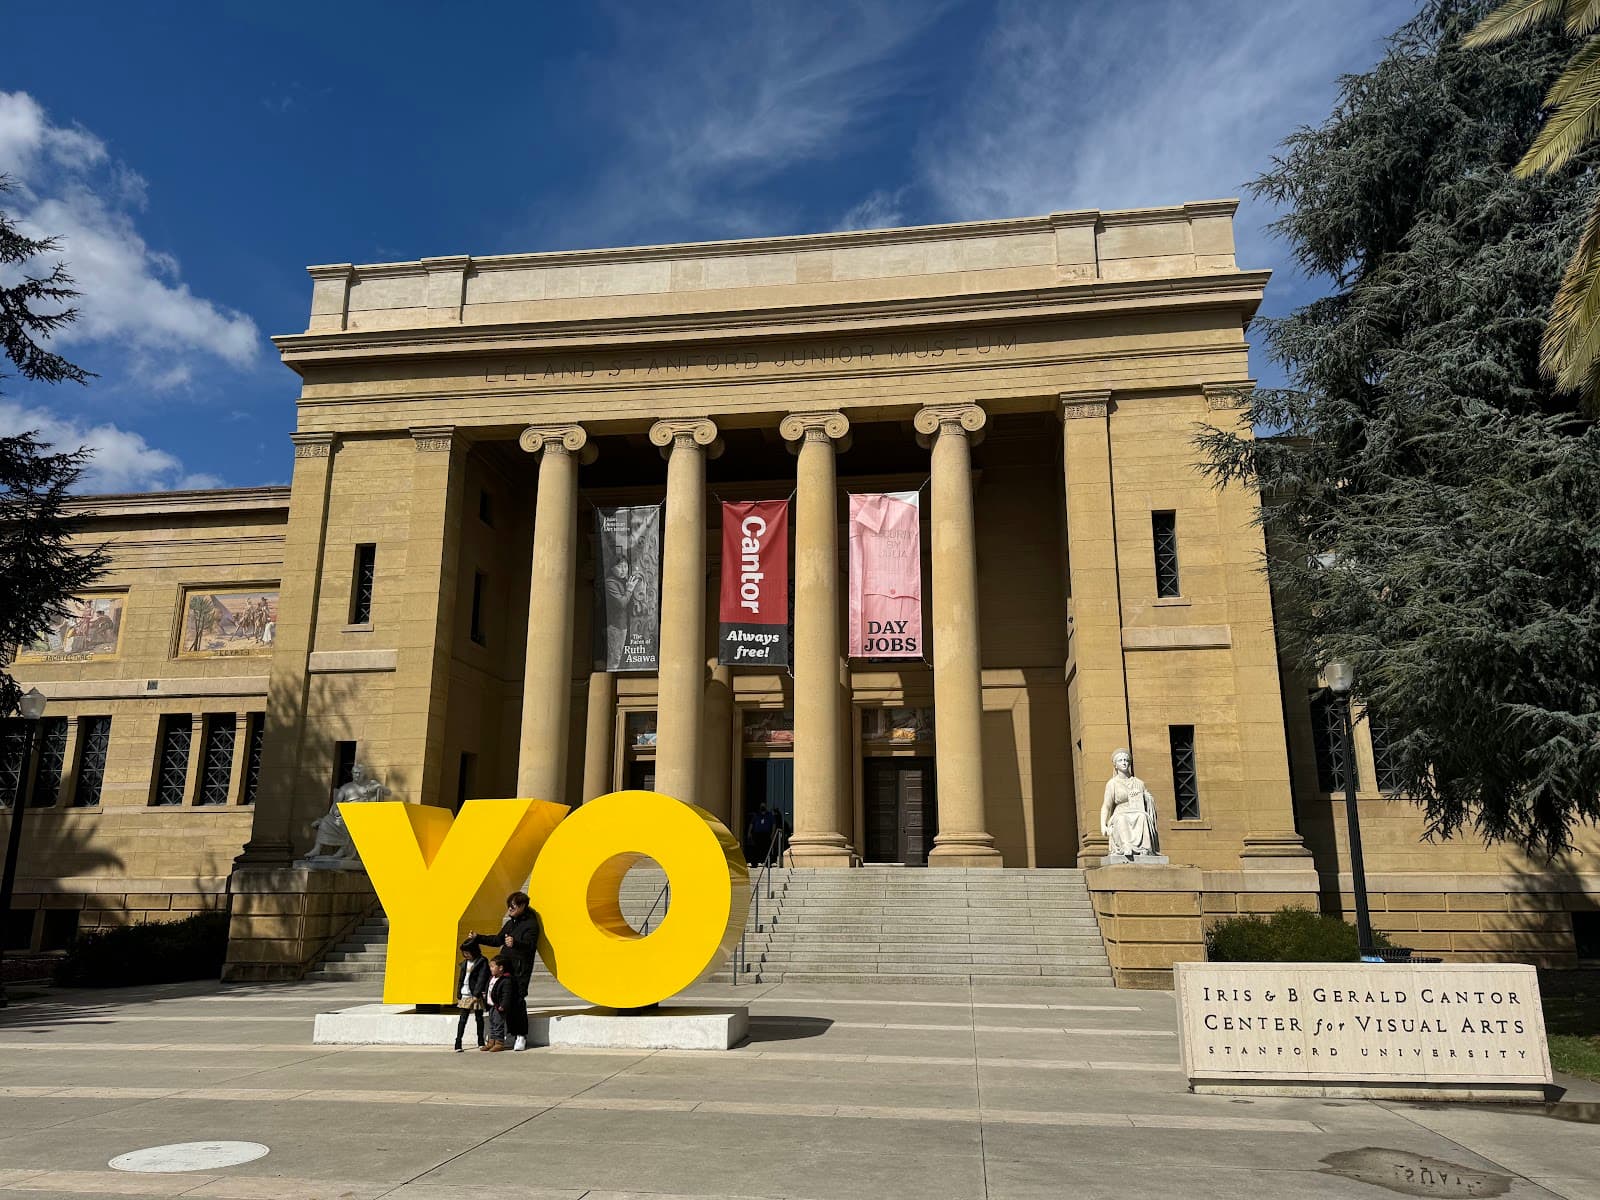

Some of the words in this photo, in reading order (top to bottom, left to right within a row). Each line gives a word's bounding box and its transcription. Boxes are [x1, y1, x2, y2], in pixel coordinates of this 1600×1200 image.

[484, 361, 595, 382] LELAND
[608, 353, 758, 376] STANFORD
[774, 345, 874, 368] JUNIOR
[890, 335, 1017, 360] MUSEUM
[740, 515, 767, 614] Cantor
[867, 621, 909, 634] DAY
[726, 630, 780, 646] Always
[864, 637, 917, 652] JOBS
[624, 645, 646, 655] Ruth
[734, 646, 770, 660] free!
[625, 655, 656, 663] Asawa
[338, 790, 735, 1009] YO
[1203, 987, 1252, 1002] IRIS
[1264, 990, 1276, 1002] &
[1287, 988, 1298, 1003] B
[1313, 988, 1407, 1004] GERALD
[1421, 988, 1521, 1005] CANTOR
[1204, 1014, 1303, 1032] CENTER
[1313, 1018, 1346, 1036] for
[1355, 1015, 1447, 1034] VISUAL
[1461, 1017, 1525, 1034] ARTS
[1208, 1046, 1338, 1057] STANFORD
[1361, 1048, 1527, 1060] UNIVERSITY
